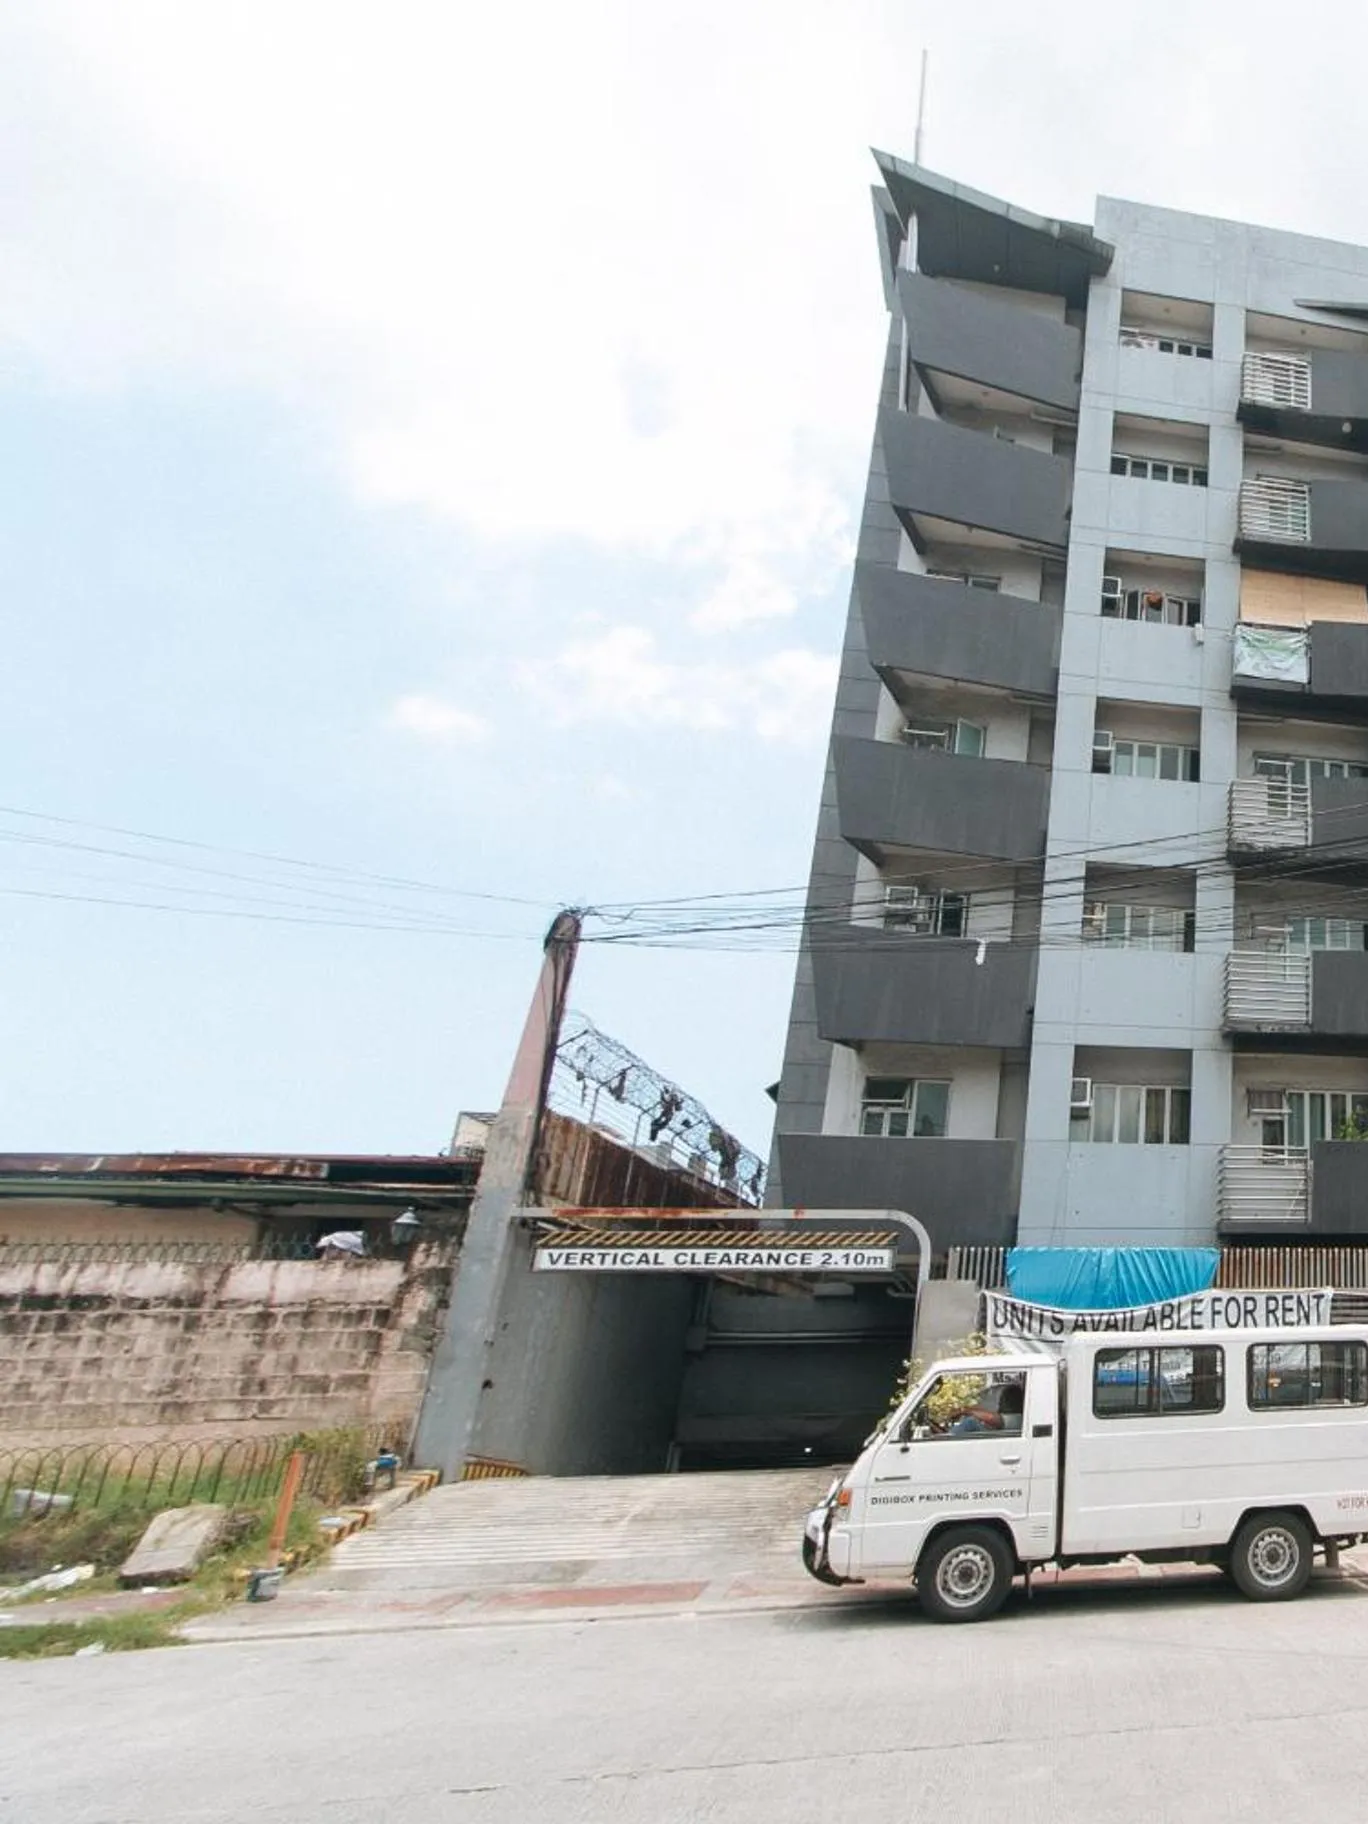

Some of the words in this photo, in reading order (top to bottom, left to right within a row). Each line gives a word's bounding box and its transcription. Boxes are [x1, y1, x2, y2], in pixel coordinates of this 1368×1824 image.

[547, 1251, 665, 1267] VERTICAL
[673, 1251, 813, 1267] CLEARANCE
[819, 1251, 885, 1267] 2.10m
[993, 1296, 1065, 1335] UNITS
[1072, 1296, 1204, 1333] AVAILABLE
[1211, 1296, 1257, 1328] FOR
[1265, 1293, 1326, 1327] RENT
[919, 1492, 970, 1503] PRINTING
[972, 1489, 1023, 1501] SERVICES
